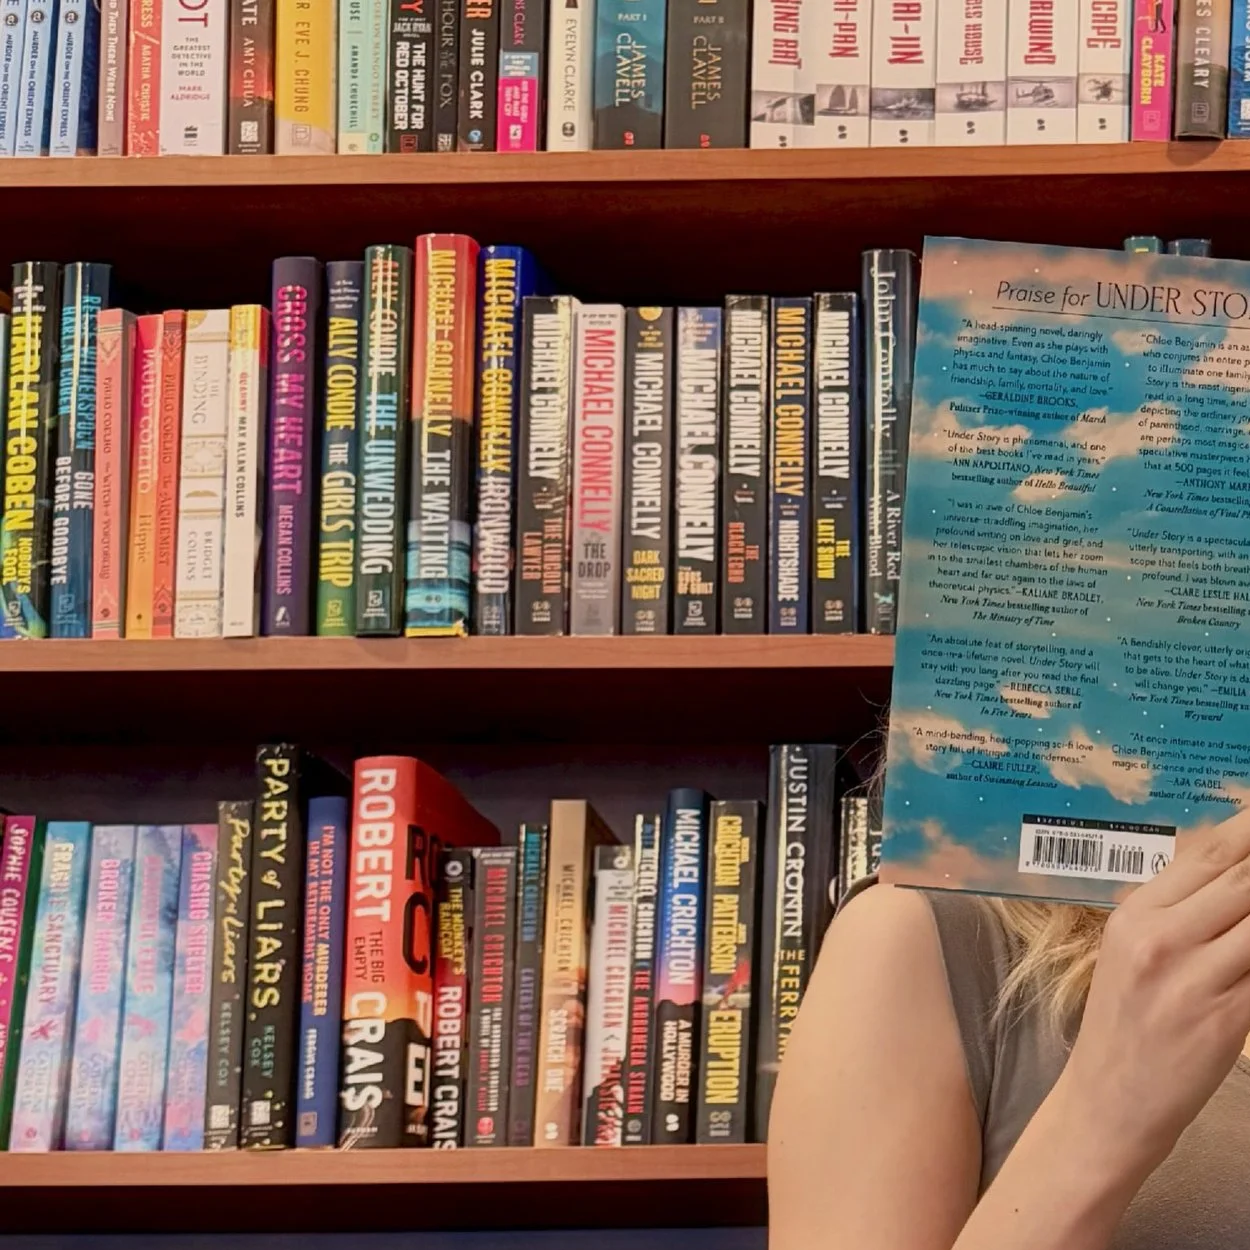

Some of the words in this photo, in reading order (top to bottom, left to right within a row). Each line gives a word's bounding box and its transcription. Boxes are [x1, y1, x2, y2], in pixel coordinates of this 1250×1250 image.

[299, 20, 309, 44] EVE
[472, 30, 485, 66] JULIE
[244, 38, 254, 65] AMY
[397, 42, 409, 65] RED
[416, 42, 426, 64] THE
[243, 68, 256, 106] CHUA
[413, 66, 425, 98] HUNT
[616, 33, 631, 107] CLAVELL
[631, 44, 647, 98] JAMES
[294, 67, 309, 112] CHUNG
[394, 67, 408, 130] OCTOBER
[469, 72, 484, 119] CLARK
[411, 105, 424, 130] FOR
[997, 281, 1055, 304] Praise
[1060, 285, 1090, 312] for
[1096, 283, 1181, 315] UNDER
[1068, 329, 1102, 342] daringly
[1175, 336, 1215, 350] Benjamin
[582, 329, 616, 422] MICHAEL
[329, 442, 350, 466] THE
[1175, 463, 1193, 473] 500
[1196, 467, 1221, 477] pages
[579, 427, 614, 532] CONNELLY
[952, 473, 994, 484] bestselling
[1025, 479, 1033, 487] of
[1035, 480, 1057, 489] Hello
[1058, 482, 1096, 492] Beautiful
[322, 473, 355, 531] GIRLS
[321, 538, 354, 587] TRIP
[578, 559, 611, 578] DROP
[584, 543, 606, 559] THE
[633, 550, 659, 564] DARK
[777, 520, 799, 602] NIGHTSHADE
[1130, 558, 1156, 568] scope
[1159, 560, 1175, 568] that
[1178, 561, 1199, 569] feels
[1202, 563, 1221, 571] both
[626, 568, 664, 583] SACRED
[631, 585, 660, 599] NIGHT
[261, 758, 290, 865] PARTY
[354, 769, 396, 921] ROBERT
[673, 809, 700, 889] MICHAEL
[252, 898, 285, 1008] LIARS
[370, 930, 382, 953] THE
[669, 895, 698, 985] CRICHTON
[354, 937, 365, 980] EMPTY
[368, 959, 383, 983] BIG
[343, 991, 387, 1111] CRAIS
[706, 1010, 741, 1104] ERUPTION
